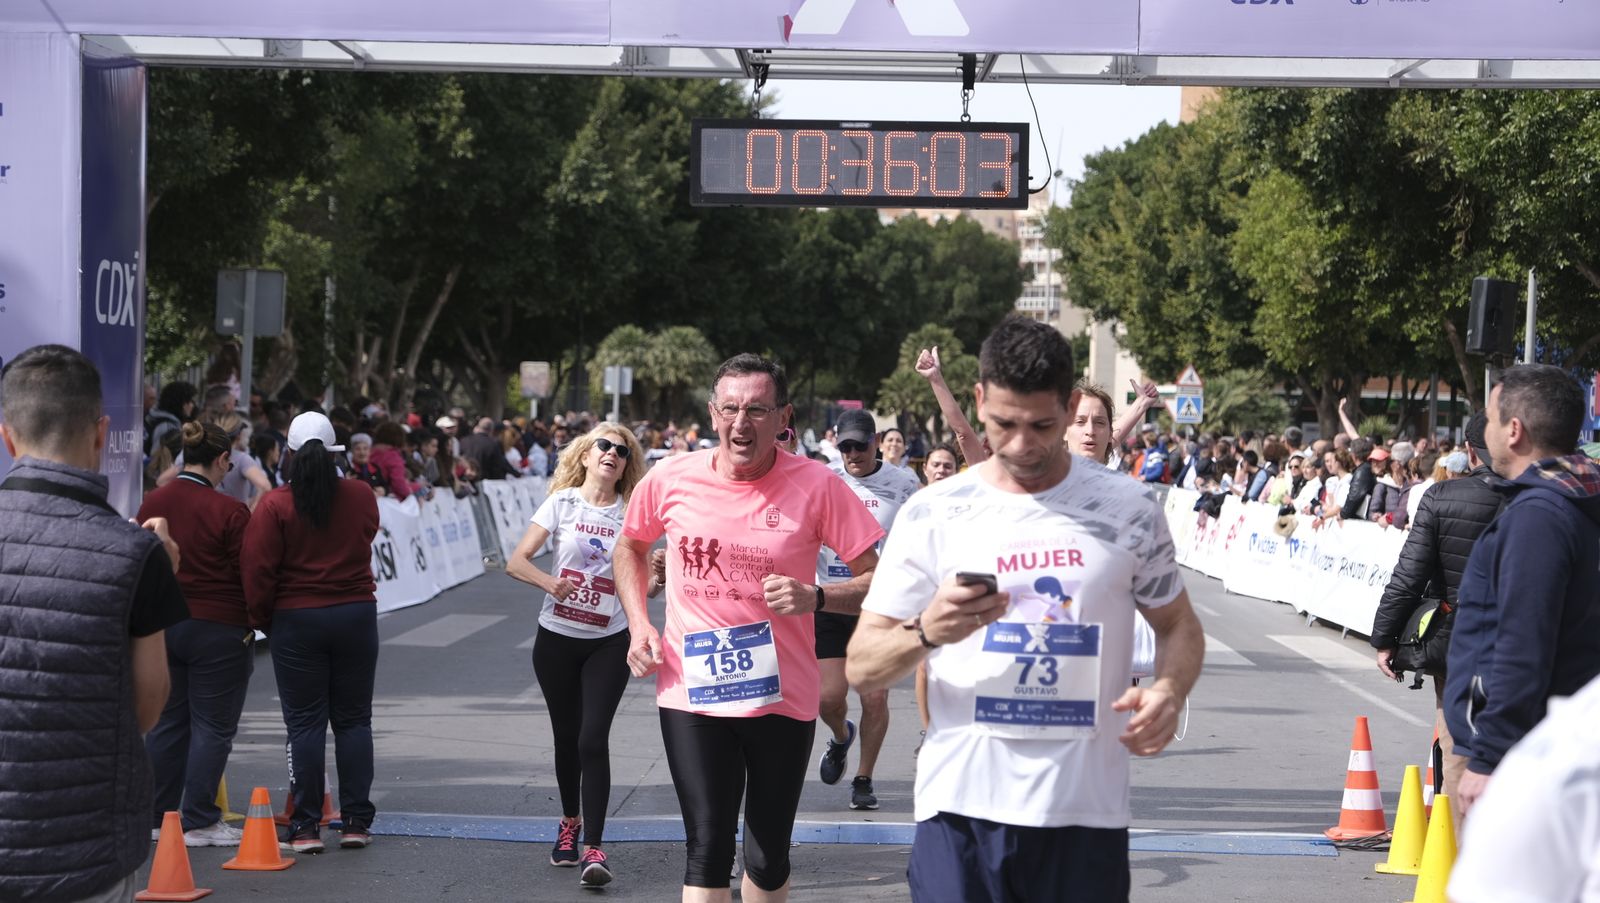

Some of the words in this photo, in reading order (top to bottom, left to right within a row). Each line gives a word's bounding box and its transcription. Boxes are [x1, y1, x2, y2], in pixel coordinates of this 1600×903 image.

[746, 128, 1012, 198] 00:36:03
[575, 523, 615, 538] MUJER
[730, 543, 768, 554] Marcha
[374, 541, 398, 582] ASI
[730, 553, 773, 564] solidaria
[997, 549, 1085, 574] MUJER
[730, 562, 762, 571] contra
[765, 564, 775, 572] el
[704, 649, 754, 676] 158
[715, 672, 747, 682] ANTONIO
[1015, 656, 1059, 686] 73
[1014, 686, 1059, 695] GUSTAVO
